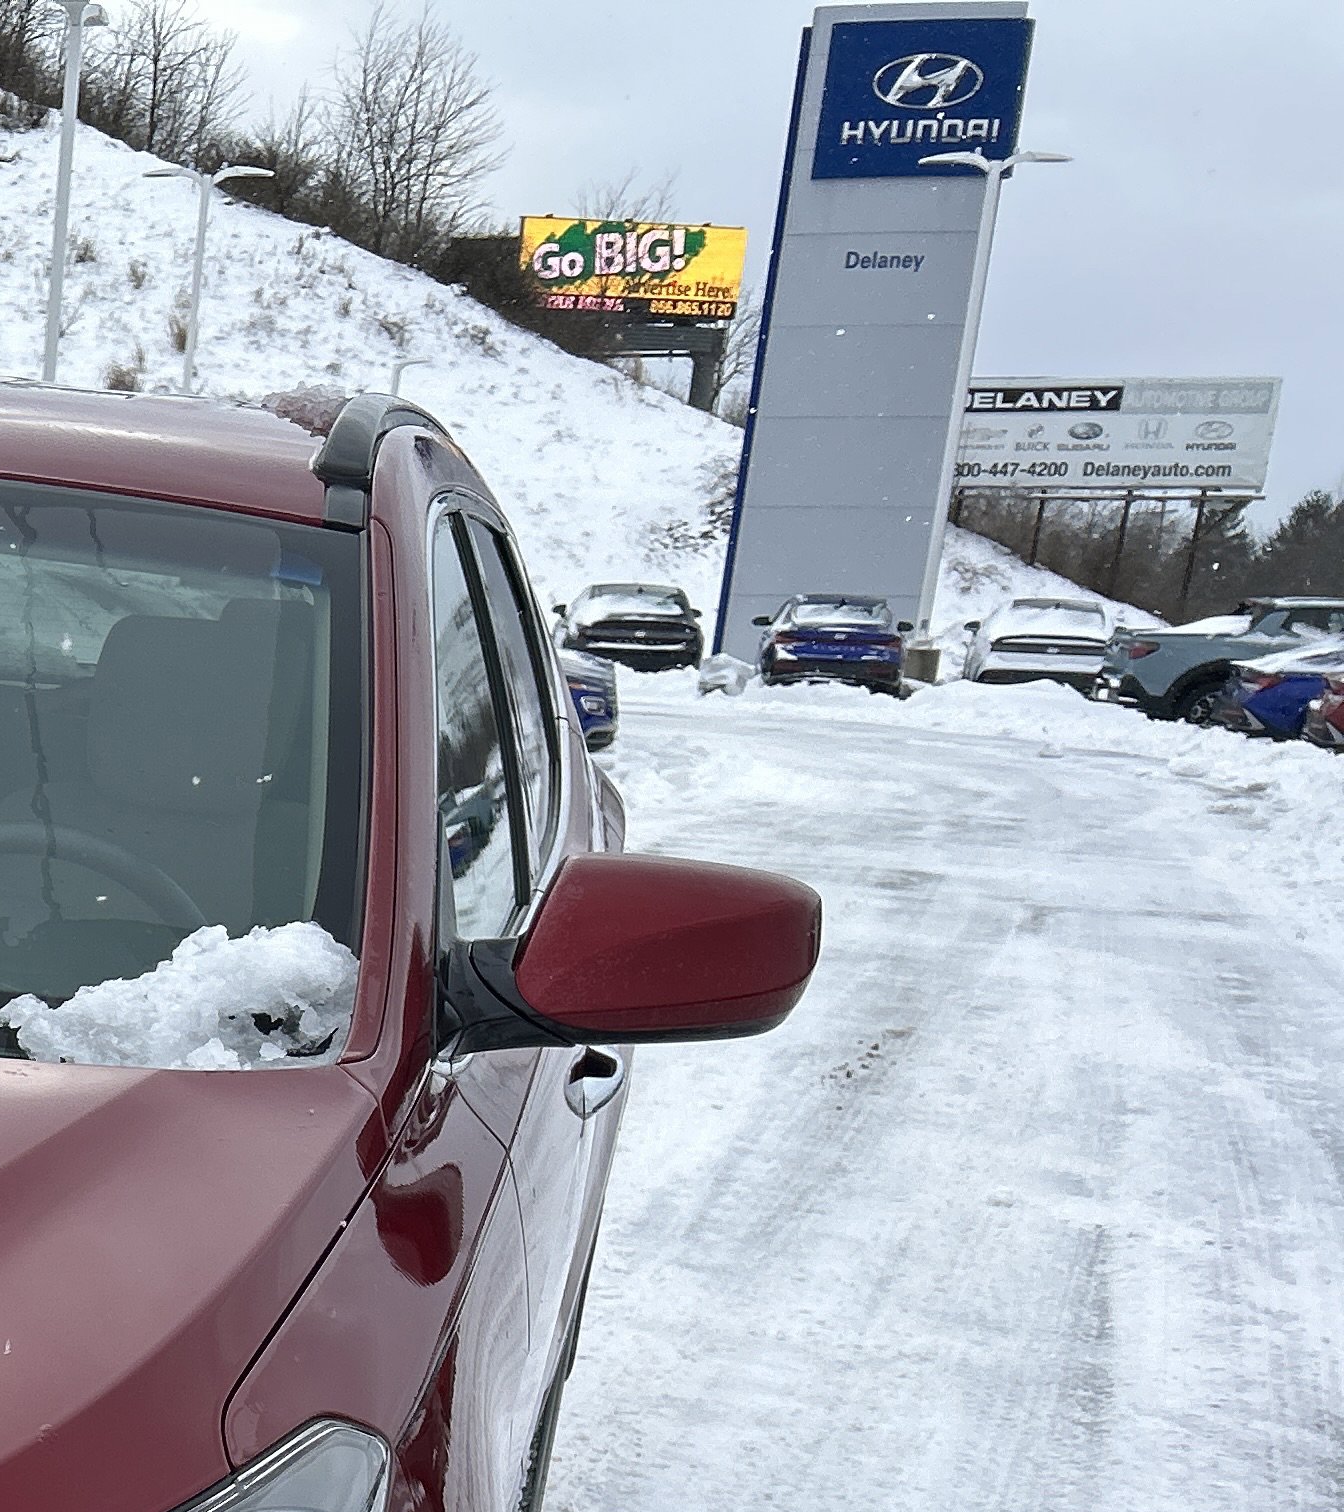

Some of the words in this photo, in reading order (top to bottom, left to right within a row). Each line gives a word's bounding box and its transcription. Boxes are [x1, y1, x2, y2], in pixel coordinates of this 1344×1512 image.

[840, 118, 1000, 145] HYUNDAI
[532, 243, 585, 280] Go
[594, 228, 687, 275] BIG!
[845, 250, 925, 272] Delaney
[1082, 461, 1232, 480] Delaneyauto.com
